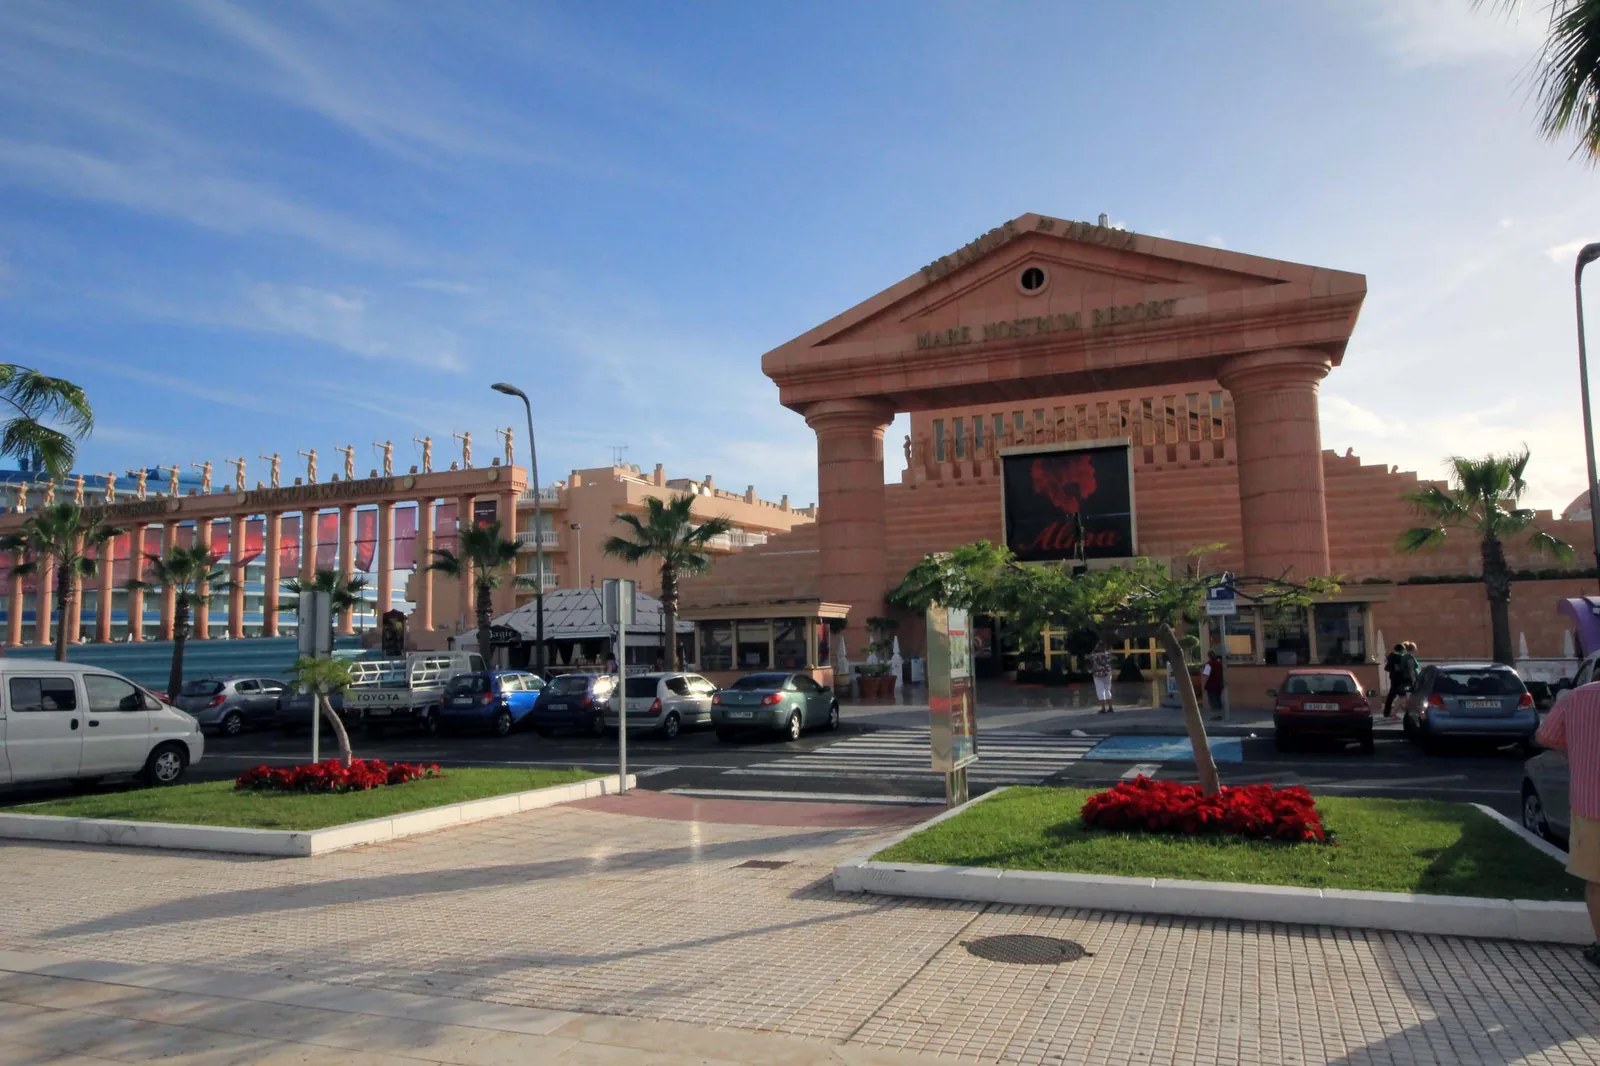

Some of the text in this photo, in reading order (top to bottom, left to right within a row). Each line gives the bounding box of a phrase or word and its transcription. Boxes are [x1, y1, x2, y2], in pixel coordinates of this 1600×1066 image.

[917, 299, 1177, 350] MARE NOSTRUM RESORT
